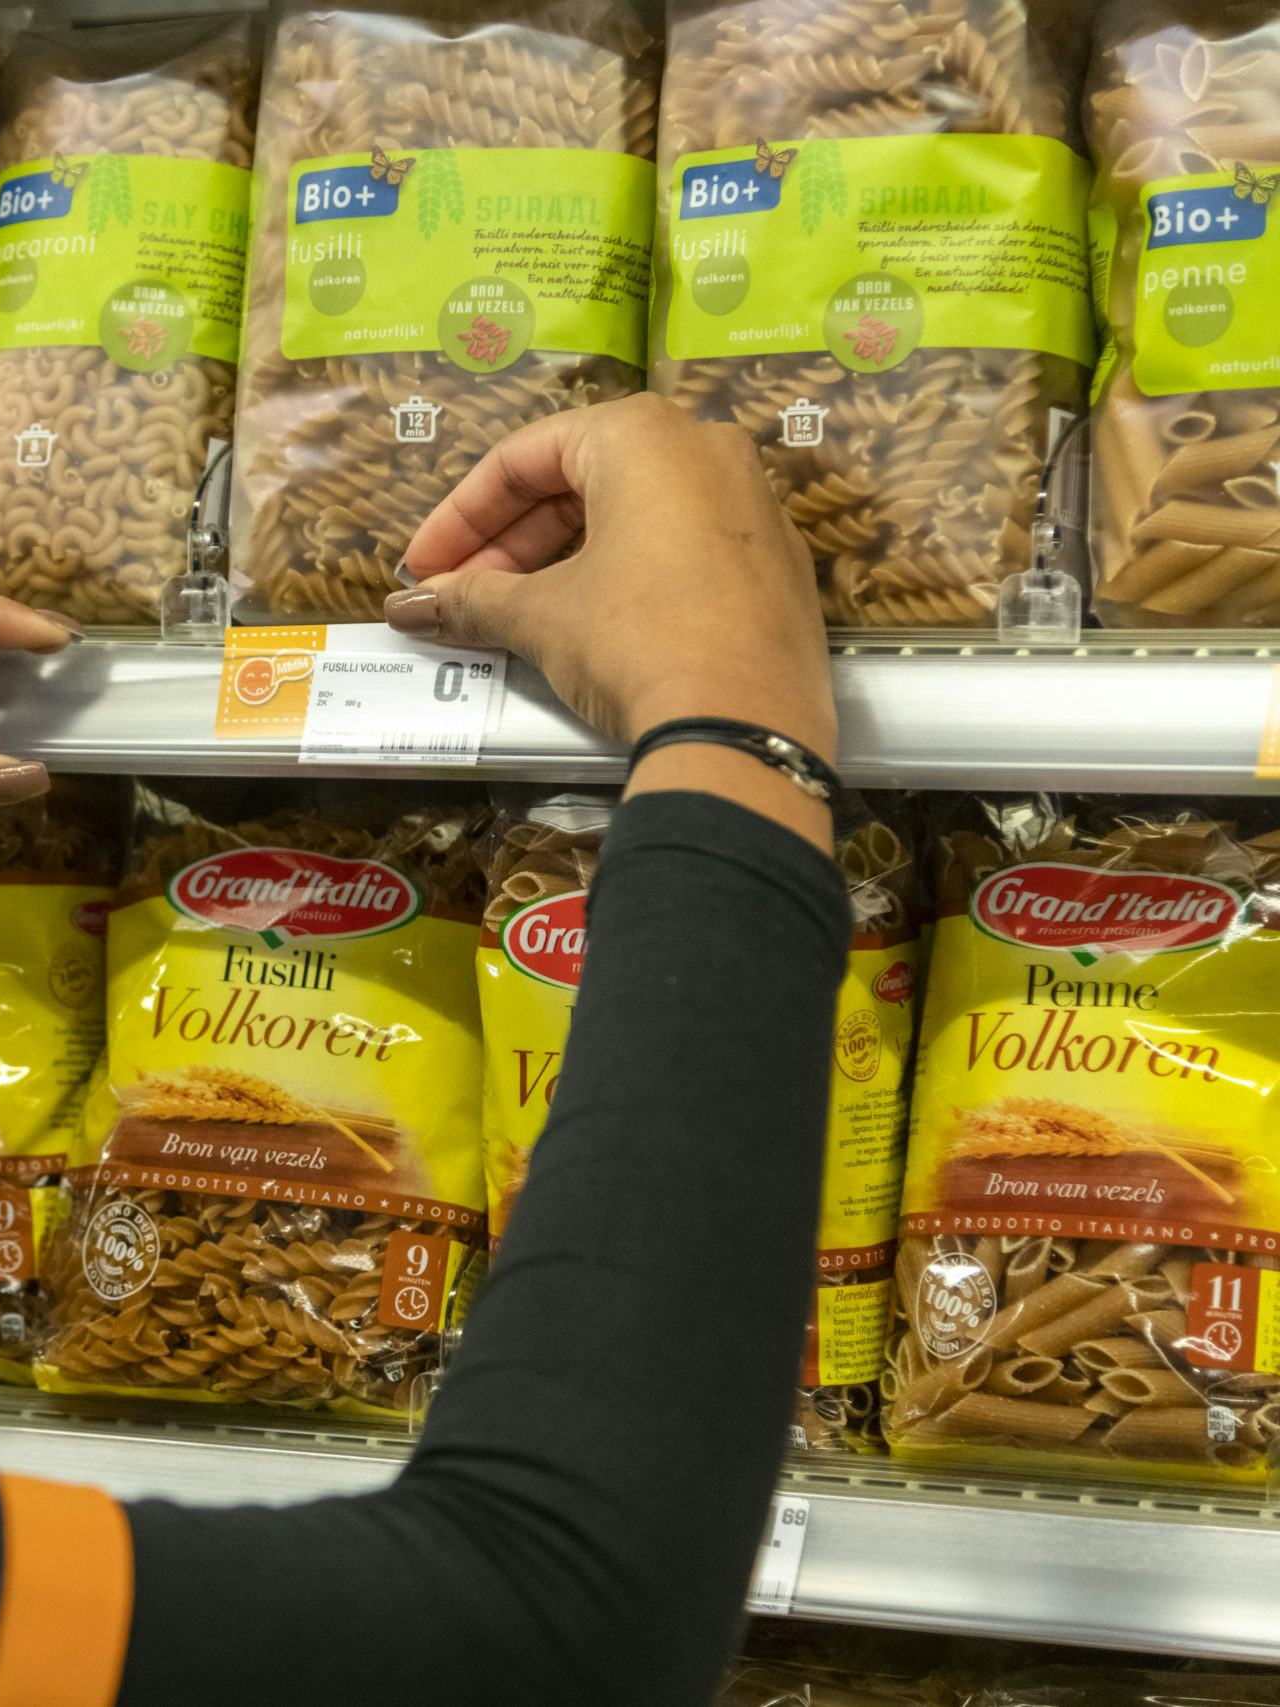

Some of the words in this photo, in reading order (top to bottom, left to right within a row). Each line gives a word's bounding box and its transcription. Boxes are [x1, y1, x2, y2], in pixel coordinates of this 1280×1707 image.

[303, 180, 375, 212] Bio+
[689, 175, 760, 208] Bio+
[859, 185, 993, 215] SPIRAAL
[142, 200, 197, 229] SAY
[476, 195, 602, 225] SPIRAAL
[1153, 201, 1239, 237] Bio+
[289, 232, 363, 266] fusilli
[672, 229, 747, 261] fusilli
[312, 274, 361, 287] volkoren
[470, 284, 504, 298] BRON
[696, 271, 744, 286] volkoren
[856, 280, 892, 295] BRON
[1144, 262, 1247, 299] penne
[139, 301, 185, 318] VEZELS
[448, 301, 474, 315] VAN
[477, 300, 525, 314] VEZELS
[834, 299, 861, 313] VAN
[864, 297, 914, 312] VEZELS
[1169, 302, 1226, 316] volkoren
[344, 323, 425, 341] natuurlijk!
[729, 323, 809, 342] natuurlijk!
[405, 427, 426, 437] min
[407, 413, 425, 428] 12
[794, 415, 812, 431] 12
[793, 431, 813, 441] min
[322, 662, 359, 674] FUSILLI
[360, 662, 414, 674] VOLKOREN
[187, 864, 403, 913] Grand'Italia
[987, 878, 1226, 924] Grand'Italia
[289, 908, 342, 925] pastaio
[1037, 925, 1099, 938] maestro
[219, 943, 338, 992] Fusilli
[1022, 964, 1159, 1012] Penne
[152, 985, 394, 1062] Volkoren
[842, 1034, 877, 1058] 100%
[966, 1009, 1221, 1083] Volkoren
[160, 1132, 215, 1158] Bron
[220, 1144, 258, 1165] van
[264, 1146, 328, 1171] vezels
[141, 1171, 250, 1194] PRODOTTO
[263, 1179, 366, 1208] ITALIANO
[984, 1172, 1039, 1197] Bron
[1046, 1182, 1088, 1200] van
[1094, 1178, 1165, 1203] vezels
[955, 1217, 1063, 1232] PRODOTTO
[1079, 1220, 1194, 1240] ITALIANO
[95, 1230, 145, 1272] 100%
[406, 1244, 429, 1277] 9
[819, 1249, 886, 1268] ODOTTO
[924, 1282, 982, 1329] 100%
[1208, 1274, 1243, 1312] 11
[781, 1508, 807, 1526] 69
